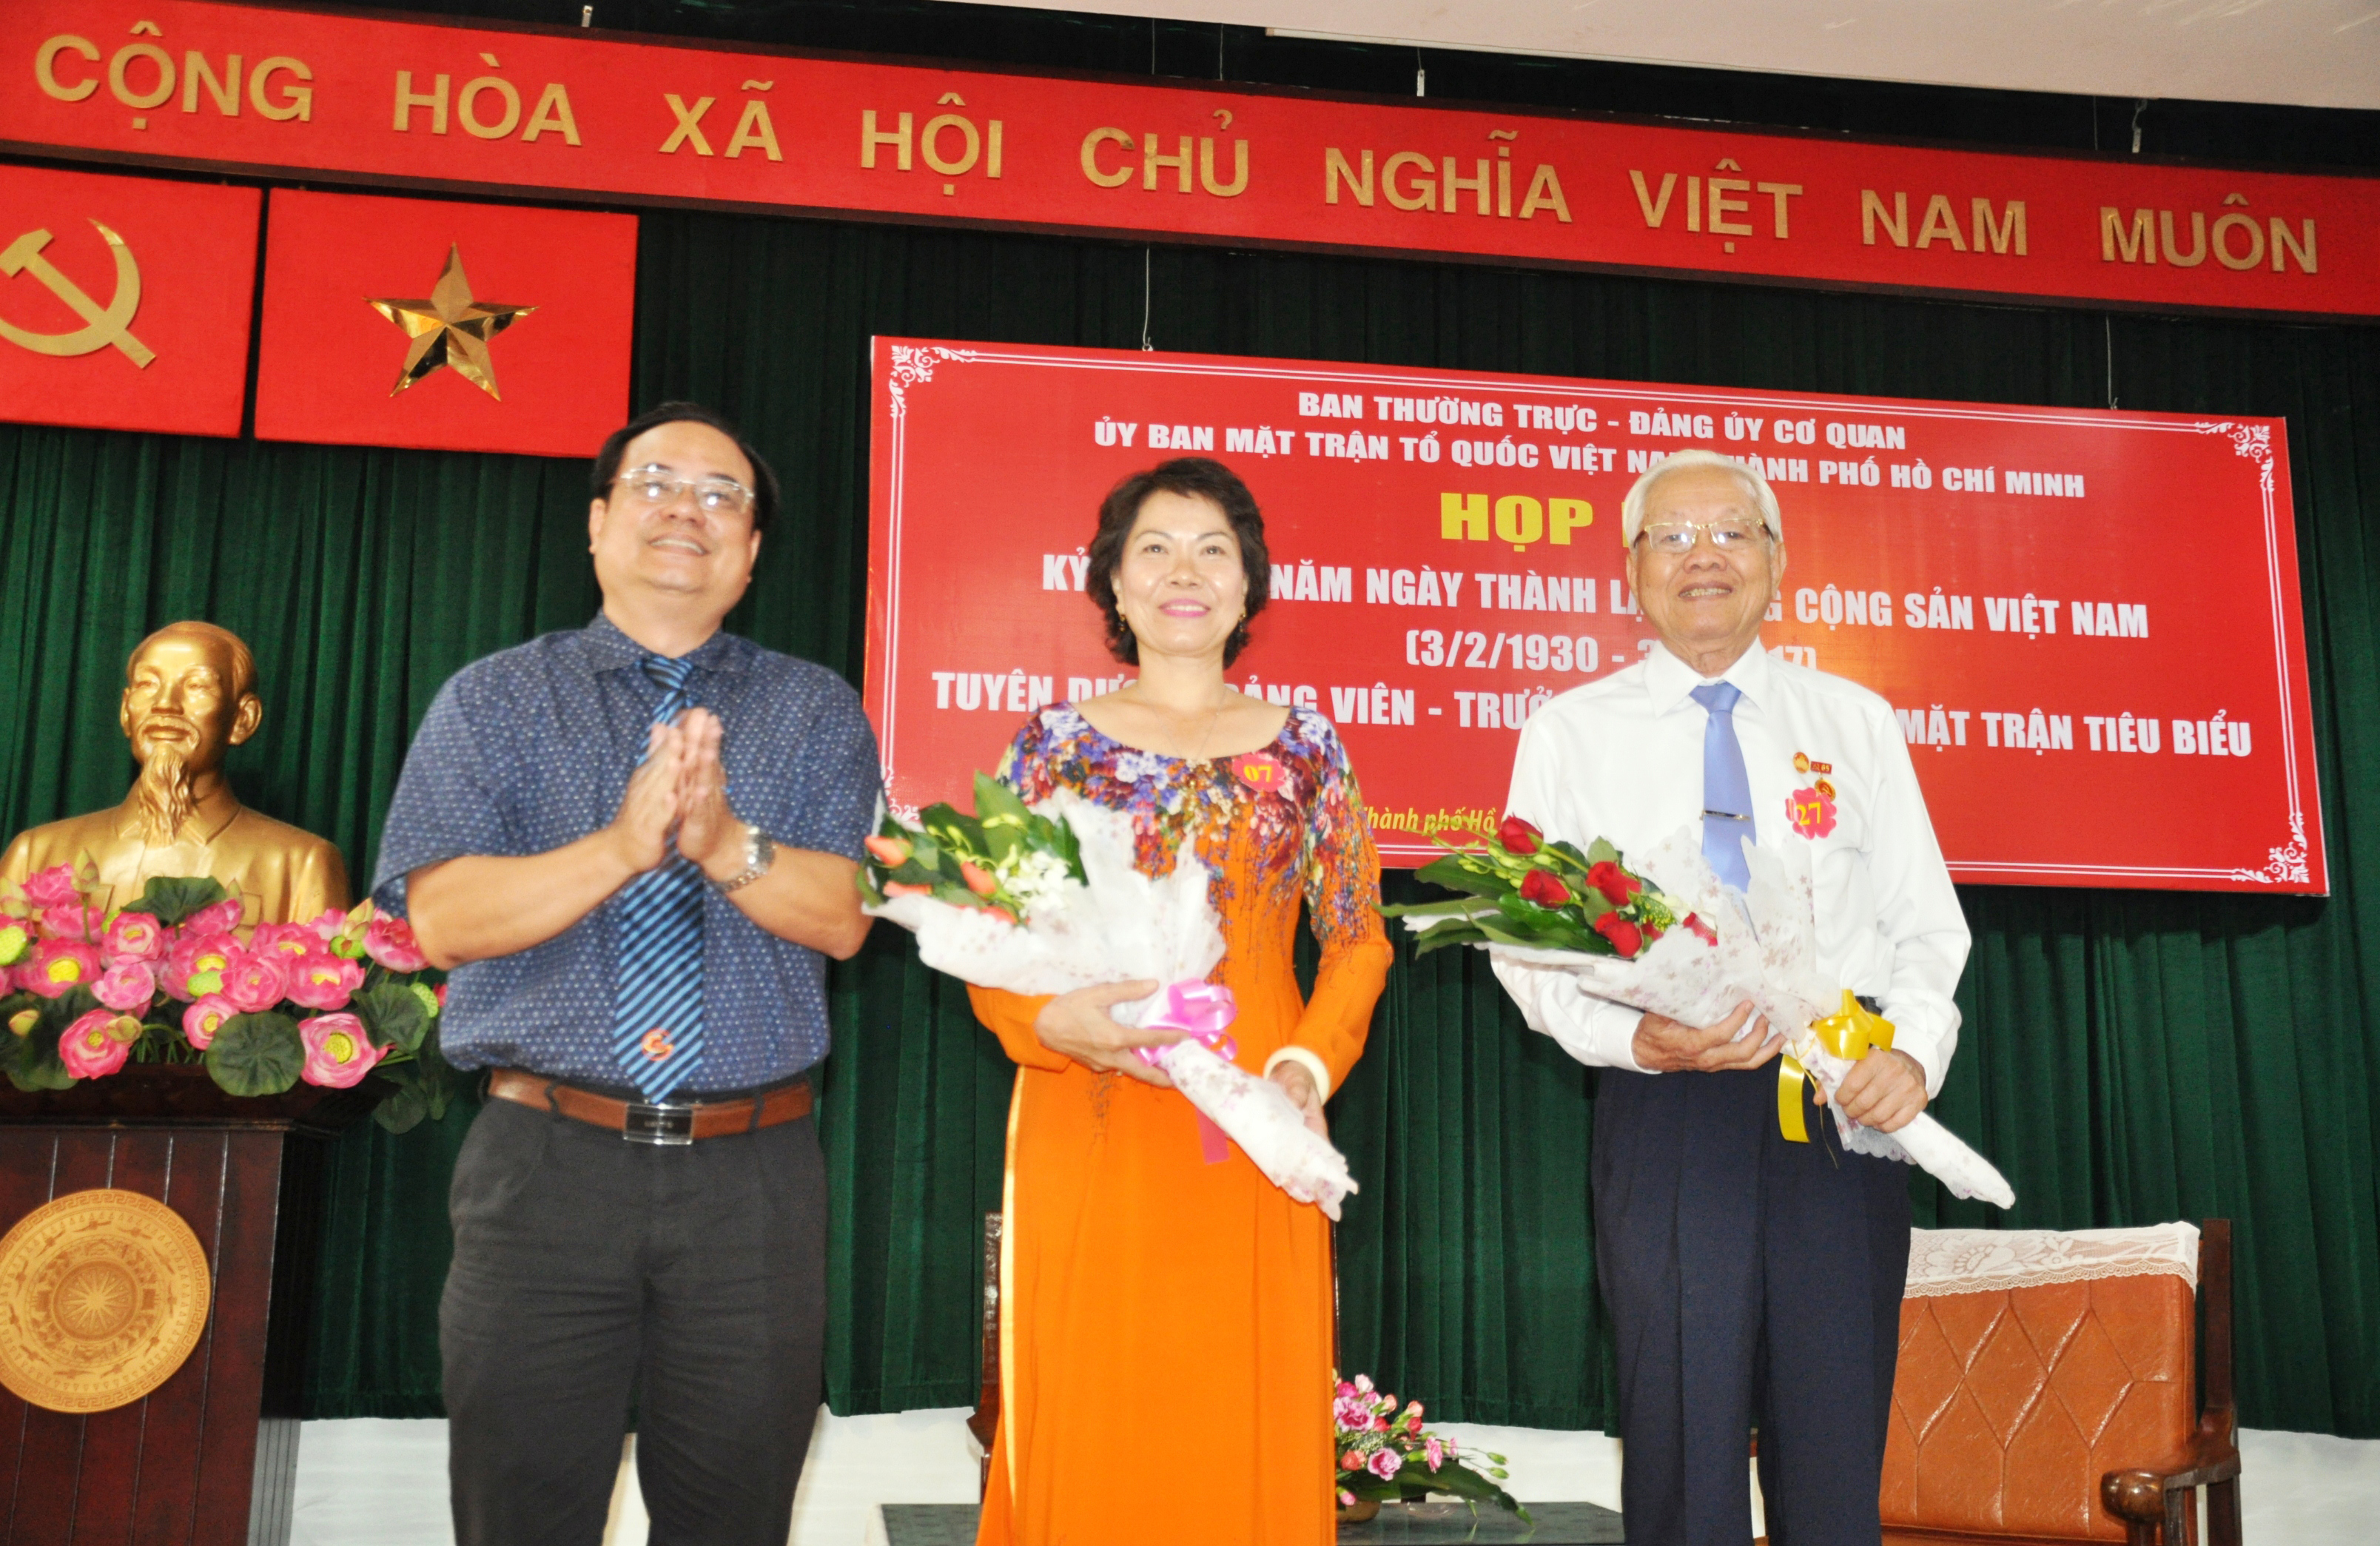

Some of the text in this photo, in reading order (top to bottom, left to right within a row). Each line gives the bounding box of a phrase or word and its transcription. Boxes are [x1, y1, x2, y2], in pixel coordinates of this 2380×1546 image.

[36, 21, 2318, 274] CỘNG HÒA XÃ HỘI CHỦ NGHĨA VIỆT NAM MUÔN
[1300, 392, 1362, 418] BAN
[1374, 397, 1502, 426] THƯỜNG
[1513, 405, 1596, 434] TRỰC
[1629, 407, 1713, 438] ĐẢNG
[1725, 411, 1763, 440] ỦY
[1774, 419, 1815, 444] CƠ
[1826, 423, 1905, 449] QUAN
[1095, 416, 2084, 497] ỦY BAN MẶT TRẬN TỔ QUỐC VIỆT NA ÀNH PHỐ HỒ CHÍ MINH
[1441, 493, 1593, 552] HỌP
[1043, 547, 1090, 591] KỶ
[1271, 559, 1351, 602] NĂM
[1367, 565, 1463, 607] NGÀY
[1475, 570, 1596, 613] THÀNH
[1795, 584, 1892, 631] CỘNG
[1904, 586, 1973, 629] SẢN
[1984, 594, 2059, 639] VIỆT
[2071, 602, 2148, 638] NAM
[1407, 631, 1599, 672] (3/2/1930
[932, 668, 1053, 713] TUYÊN
[1225, 675, 1317, 712] ẢNG
[1330, 682, 1414, 726] VIÊN
[1895, 704, 1970, 752] MẶT
[1981, 708, 2073, 755] TRẬN
[2084, 712, 2160, 753] TIÊU
[2173, 710, 2251, 756] BIỂU
[1244, 765, 1272, 783] 07
[1364, 806, 1419, 830] hành
[1468, 807, 1496, 833] Hồ
[1796, 801, 1821, 826] 27
